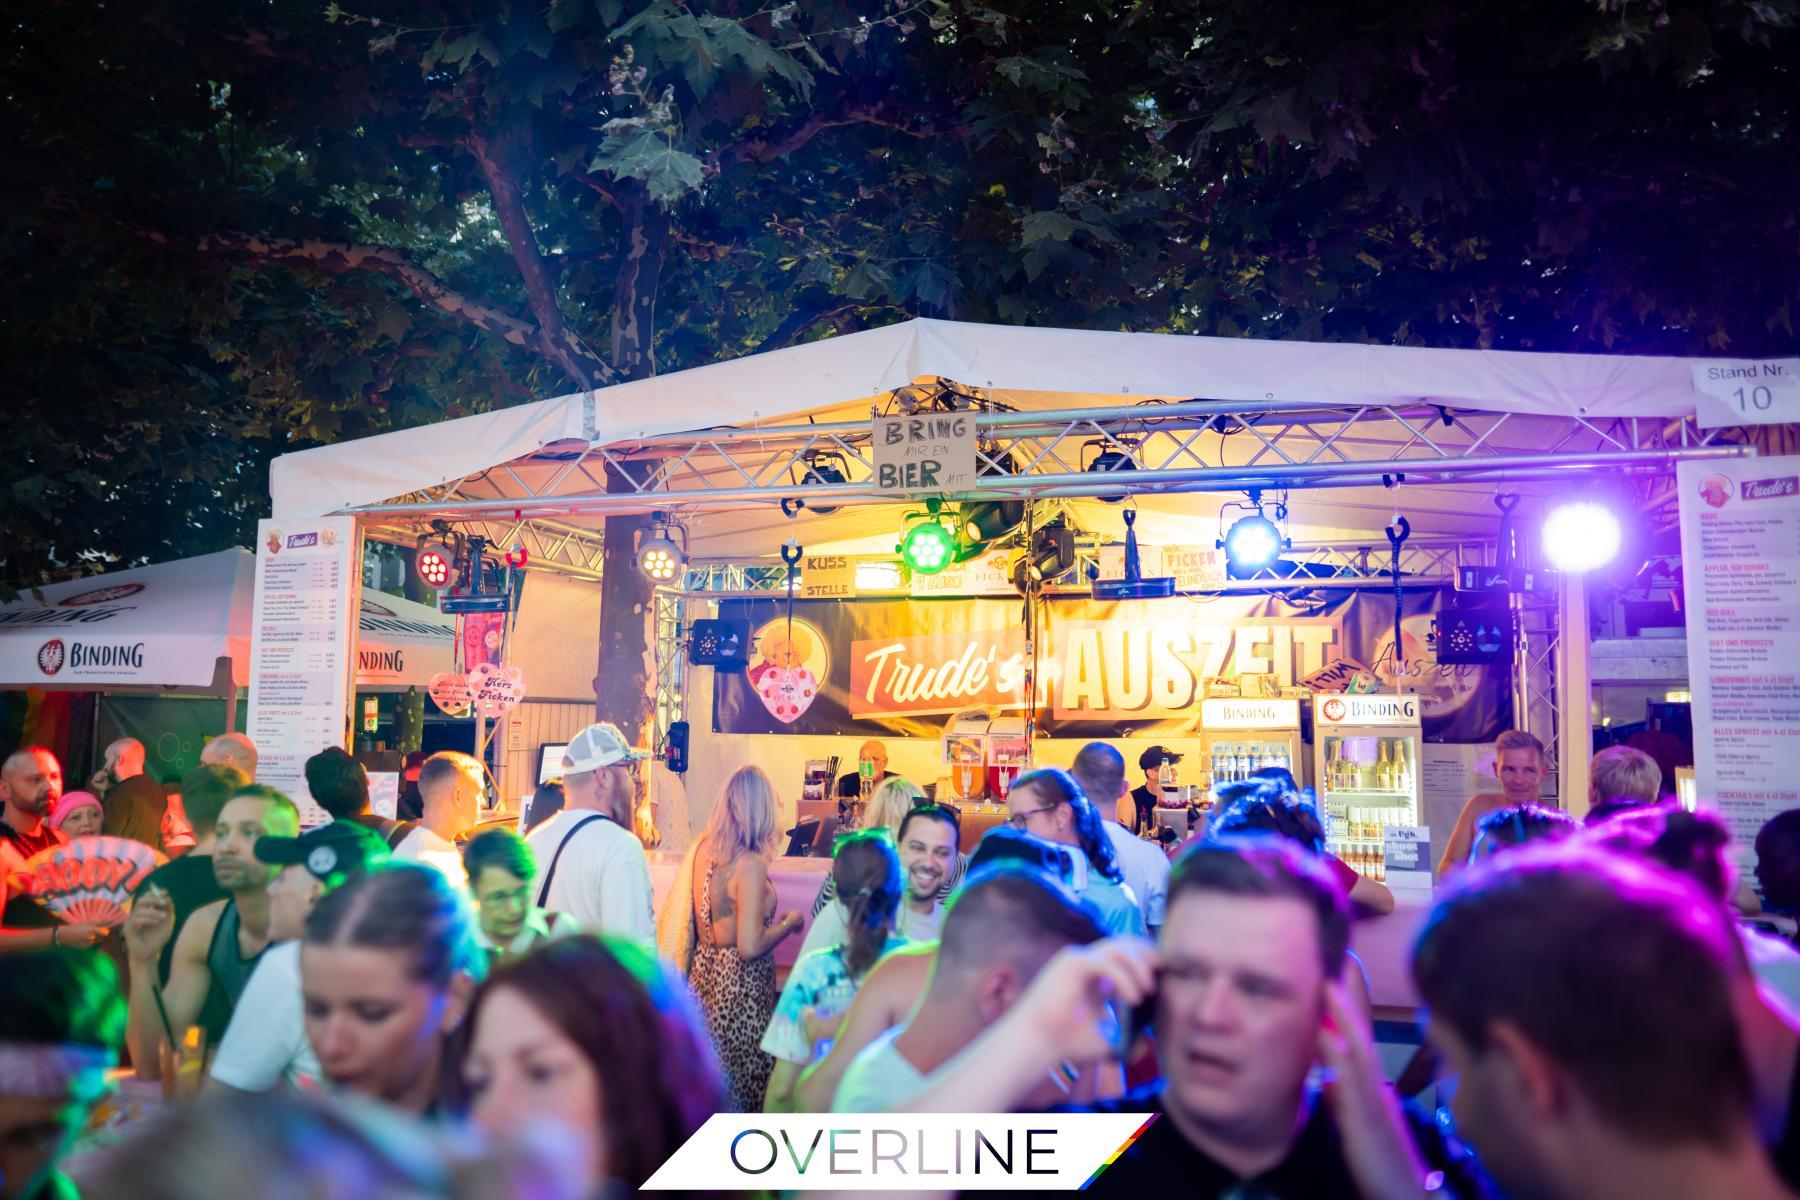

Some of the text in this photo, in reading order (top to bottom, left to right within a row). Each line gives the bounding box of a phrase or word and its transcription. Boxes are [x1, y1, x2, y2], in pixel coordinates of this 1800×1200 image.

[1708, 363, 1790, 380] Stand Nr.
[1732, 385, 1772, 411] 10
[885, 418, 966, 445] BRING
[904, 445, 949, 458] MIR EIN
[879, 460, 942, 488] BIER
[1744, 479, 1794, 498] Trude's
[808, 556, 847, 570] KUSS
[1168, 551, 1216, 567] FICKEN
[807, 585, 848, 596] STELLE
[70, 643, 144, 668] BINDING
[359, 650, 403, 672] NDING
[865, 625, 1333, 711] Trude's AUSZEIT
[484, 677, 513, 689] Herz
[477, 689, 515, 703] Ficken
[1223, 705, 1275, 720] BINDING
[1351, 701, 1414, 718] BINDING
